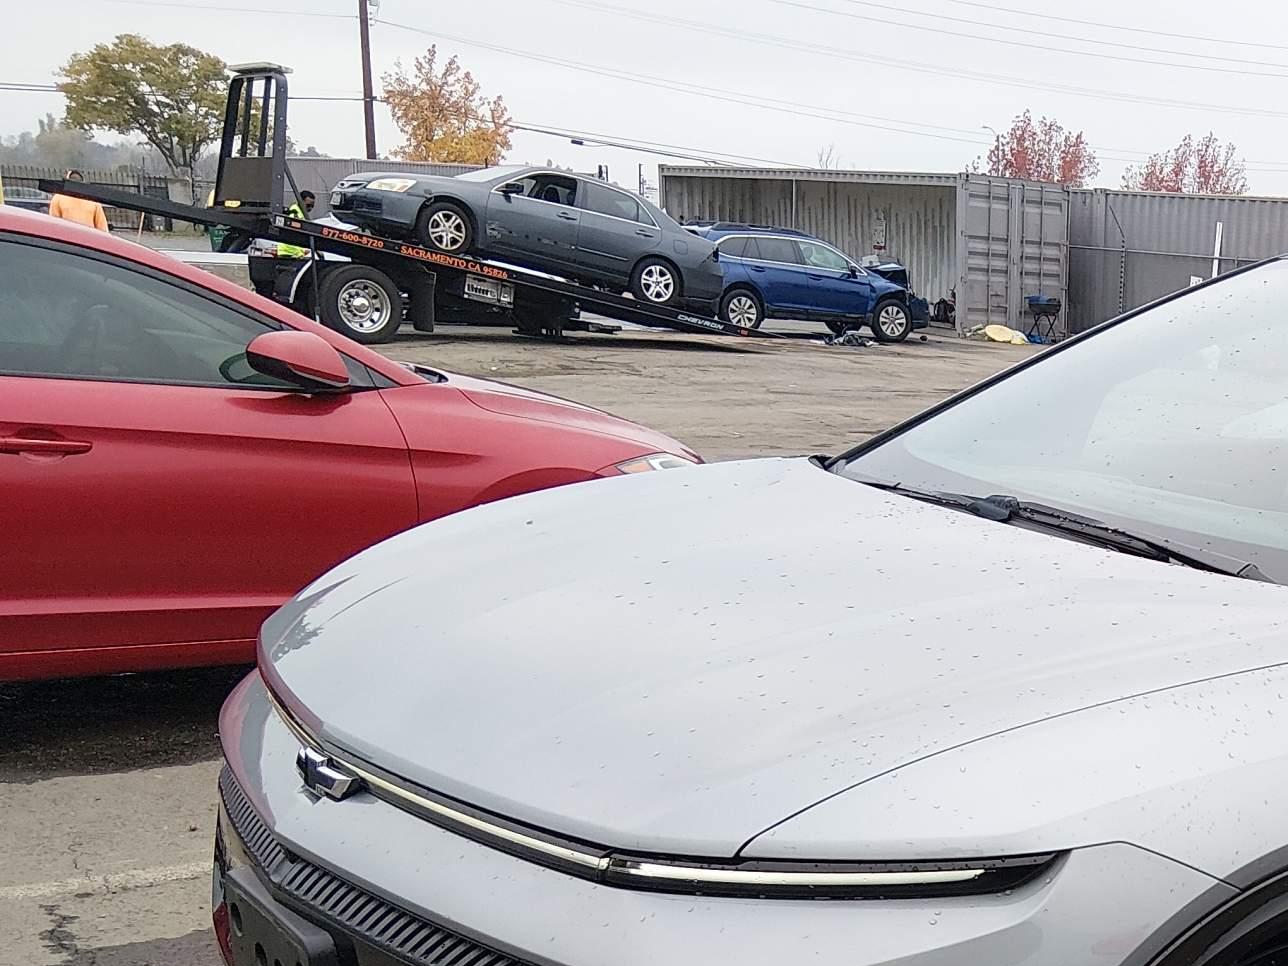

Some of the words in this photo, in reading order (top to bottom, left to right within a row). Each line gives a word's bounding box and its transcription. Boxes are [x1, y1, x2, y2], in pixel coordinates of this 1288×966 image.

[322, 227, 385, 248] 877-600-8720
[400, 245, 466, 269] SACRAMENTO
[467, 261, 481, 272] CA
[482, 266, 508, 280] 95826
[677, 314, 724, 330] CHEVRON
